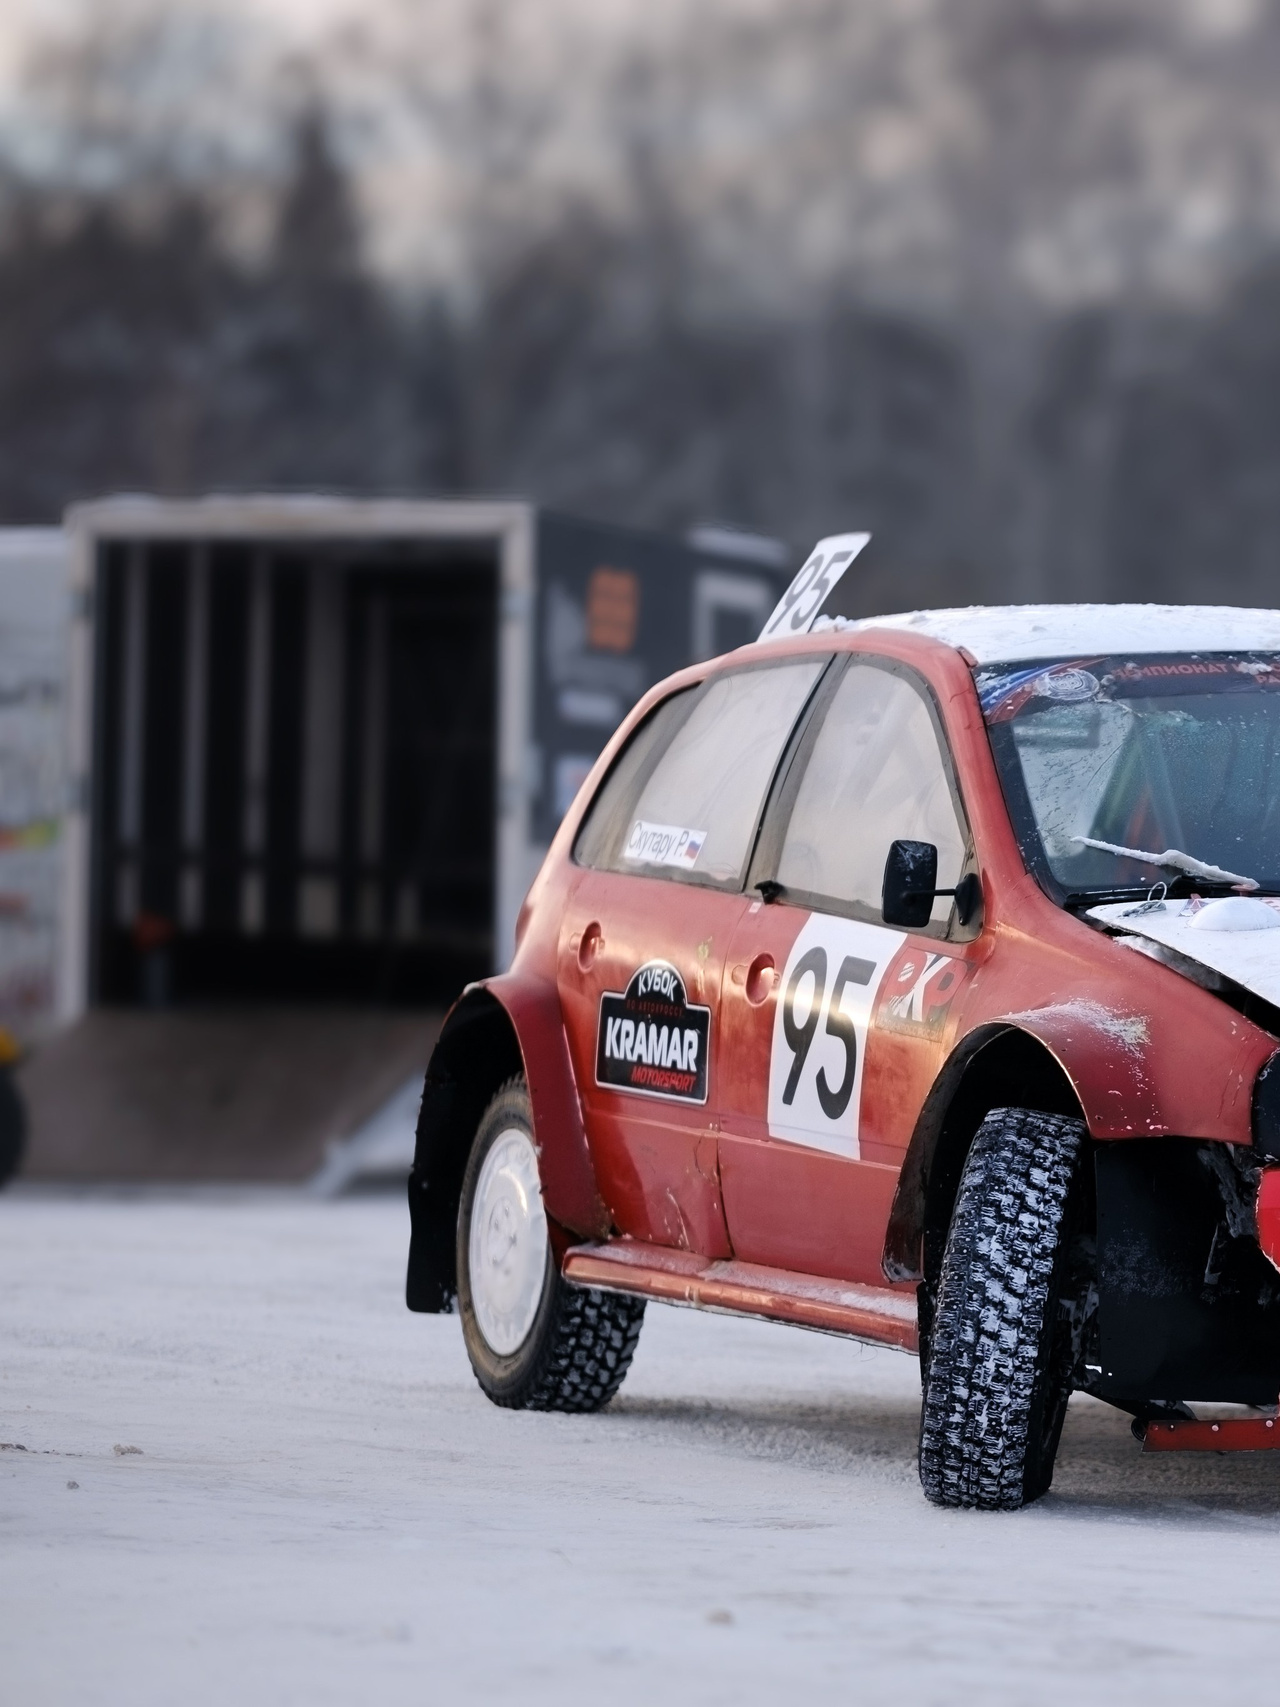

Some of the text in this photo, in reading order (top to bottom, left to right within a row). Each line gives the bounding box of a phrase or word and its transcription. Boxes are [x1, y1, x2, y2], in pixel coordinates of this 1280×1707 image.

[767, 551, 854, 634] 95
[629, 822, 690, 861] Скутару Р.
[638, 968, 678, 1001] КУБОК
[605, 1016, 699, 1072] KRAMAR
[782, 946, 877, 1120] 95
[631, 1066, 697, 1092] MOTORSPORT
